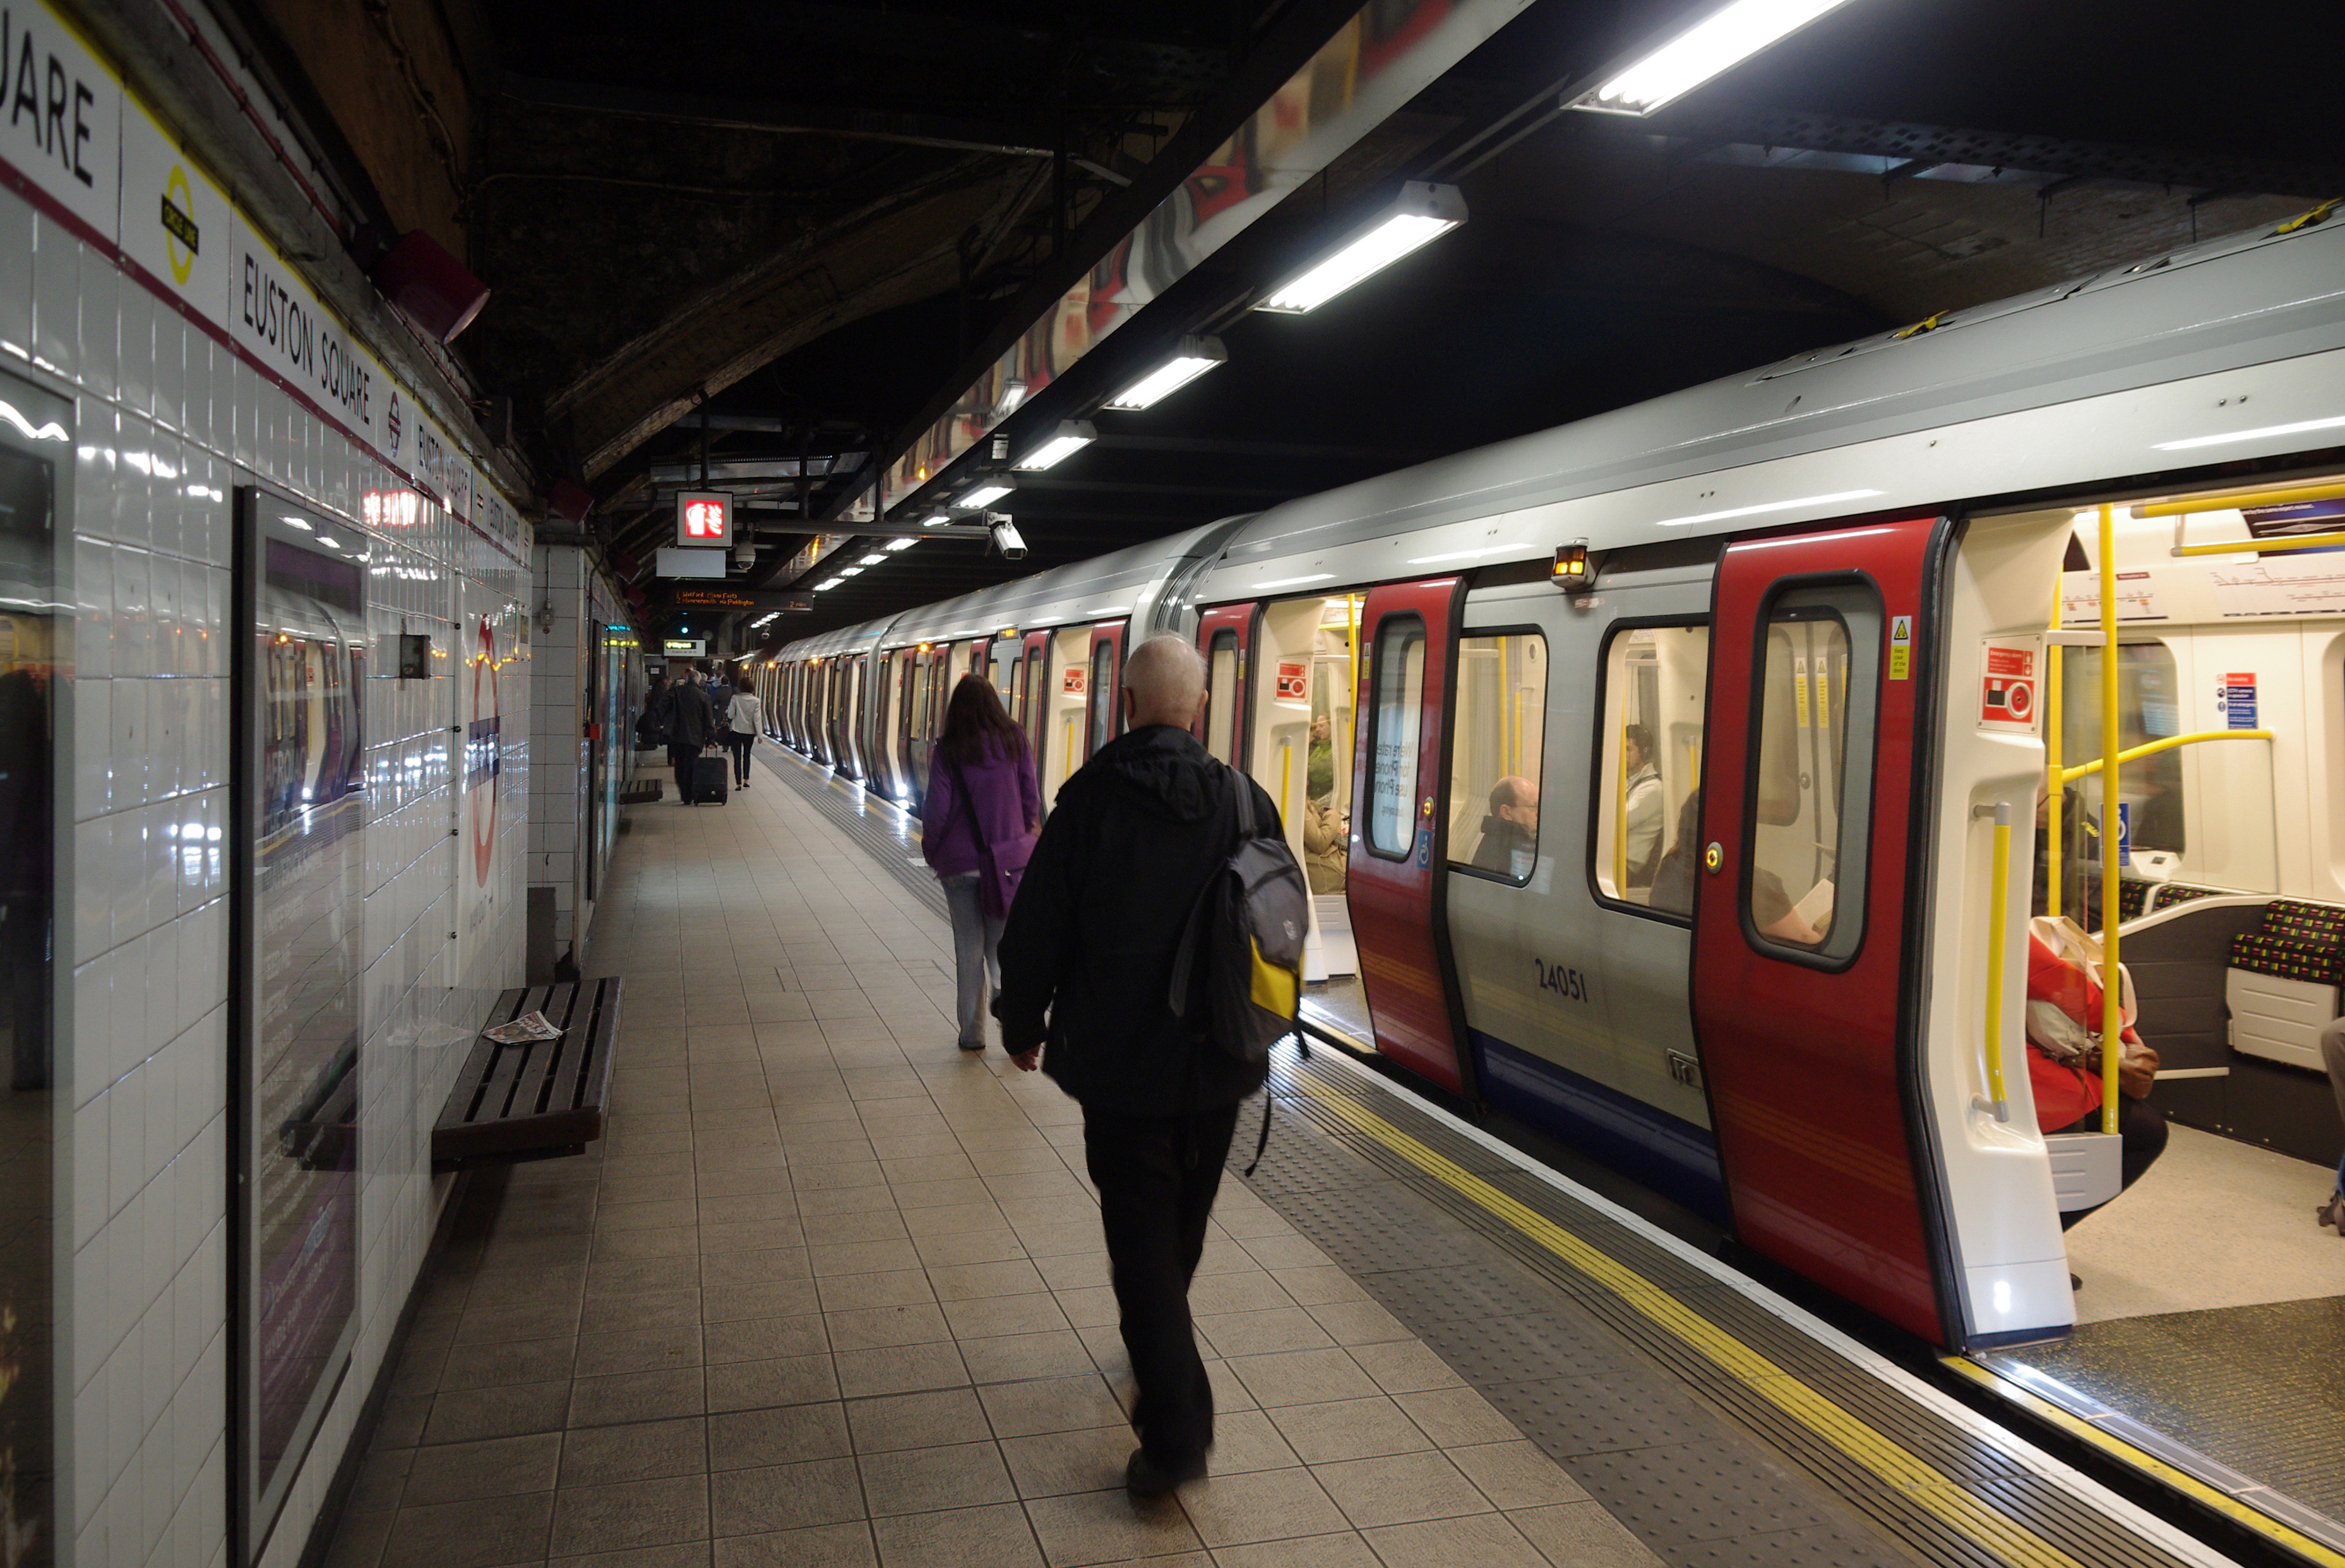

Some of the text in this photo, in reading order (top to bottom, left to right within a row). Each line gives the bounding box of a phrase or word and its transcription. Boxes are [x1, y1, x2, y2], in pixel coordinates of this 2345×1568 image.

[244, 252, 370, 425] EUSTON SQUARE
[419, 424, 445, 484] EUSTON
[1990, 650, 2010, 658] Emergency
[1534, 958, 1588, 1004] 24051
